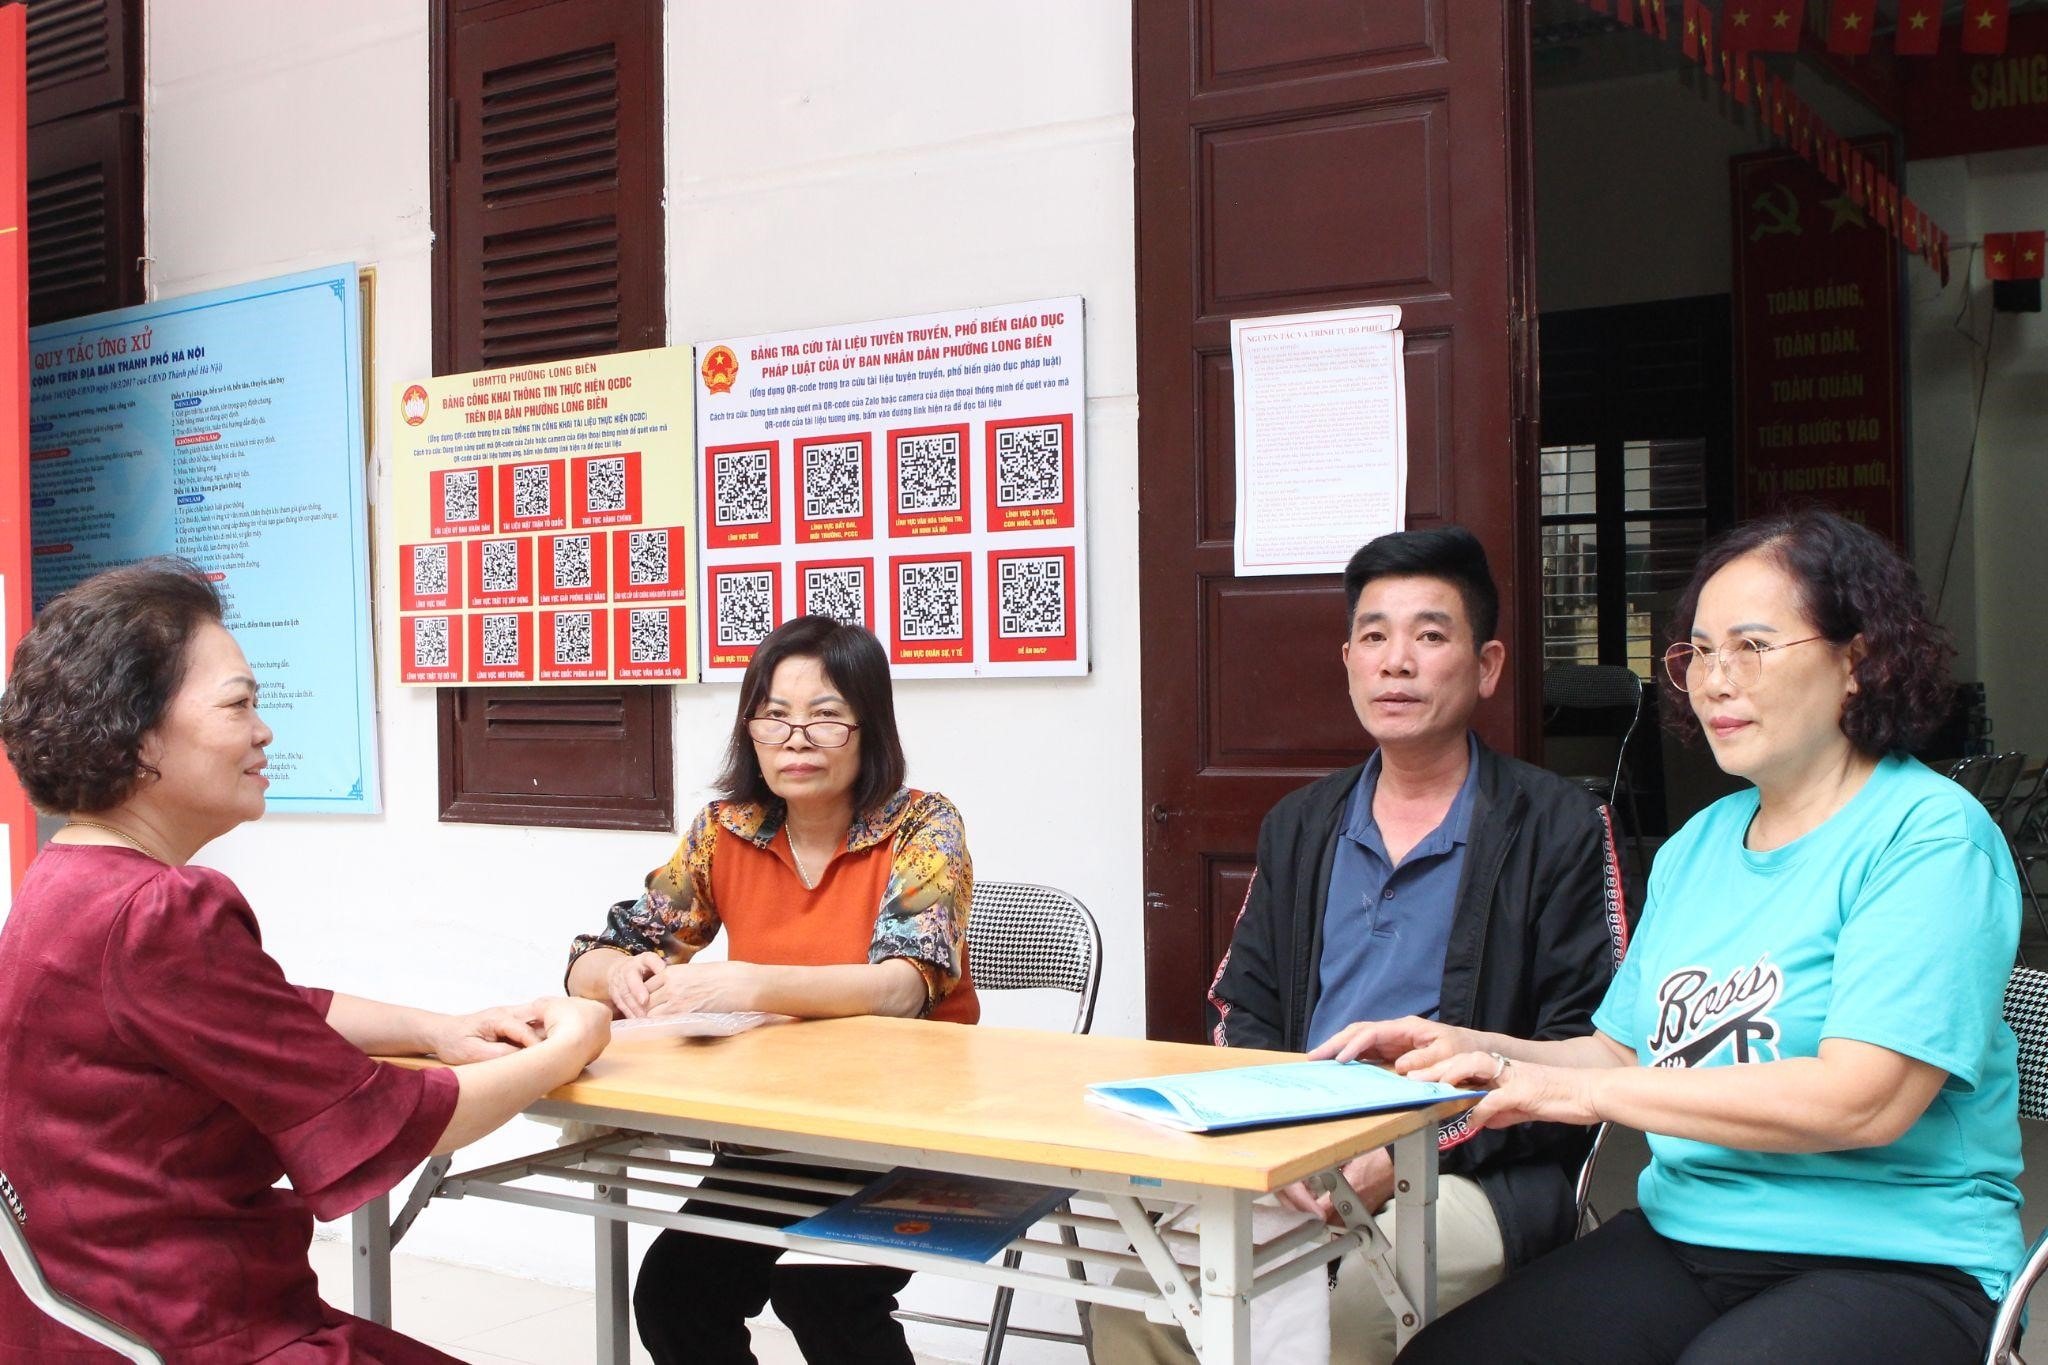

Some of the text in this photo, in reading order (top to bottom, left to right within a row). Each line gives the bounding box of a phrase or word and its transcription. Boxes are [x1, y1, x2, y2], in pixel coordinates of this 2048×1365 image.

[1767, 279, 1863, 314] TOÀN ĐẢNG,
[34, 325, 152, 370] QUY TẮC ỨNG XỬ
[750, 312, 1064, 360] BẢNG TRA CỨU TÀI LIỆU TUYÊN TRUYỀN, PHỔ BIẾN GIÁO DỤC
[1773, 326, 1860, 358] TOÀN DÂN,
[31, 345, 204, 389] CỘNG TRÊN ĐỊA BÀN THÀNH PHỐ HÀ NỘI
[762, 332, 1052, 378] PHÁP LUẬT CỦA ỦY BAN NHÂN DÂN PHƯỜNG LONG BIÊN
[472, 362, 596, 387] UBMTTQ PHƯỜNG LONG BIÊN
[767, 387, 784, 396] dụng
[786, 382, 817, 392] QR-code
[818, 381, 837, 389] trong
[839, 379, 849, 387] tra
[851, 377, 865, 385] cứu
[867, 376, 877, 384] tài
[879, 374, 893, 384] liệu
[895, 372, 916, 382] tuyên
[918, 367, 945, 379] truyền,
[947, 365, 961, 378] phổ
[963, 363, 981, 374] biến
[983, 363, 1000, 374] giáo
[1002, 362, 1017, 371] dục
[1020, 359, 1040, 370] pháp
[1042, 356, 1061, 367] luật)
[1772, 371, 1863, 403] TOÀN QUÂN
[442, 376, 632, 409] BẢNG CÔNG KHAI THÔNG TIN THỰC HIỆN QCDC
[465, 395, 608, 423] TRÊN ĐỊA BÀN PHƯỜNG LONG BIÊN
[1758, 413, 1879, 447] TIẾN BƯỚC VÀO
[1784, 462, 1847, 490] NGUYÊN
[1854, 459, 1891, 488] MỚI,
[1650, 957, 1777, 1051] Boss
